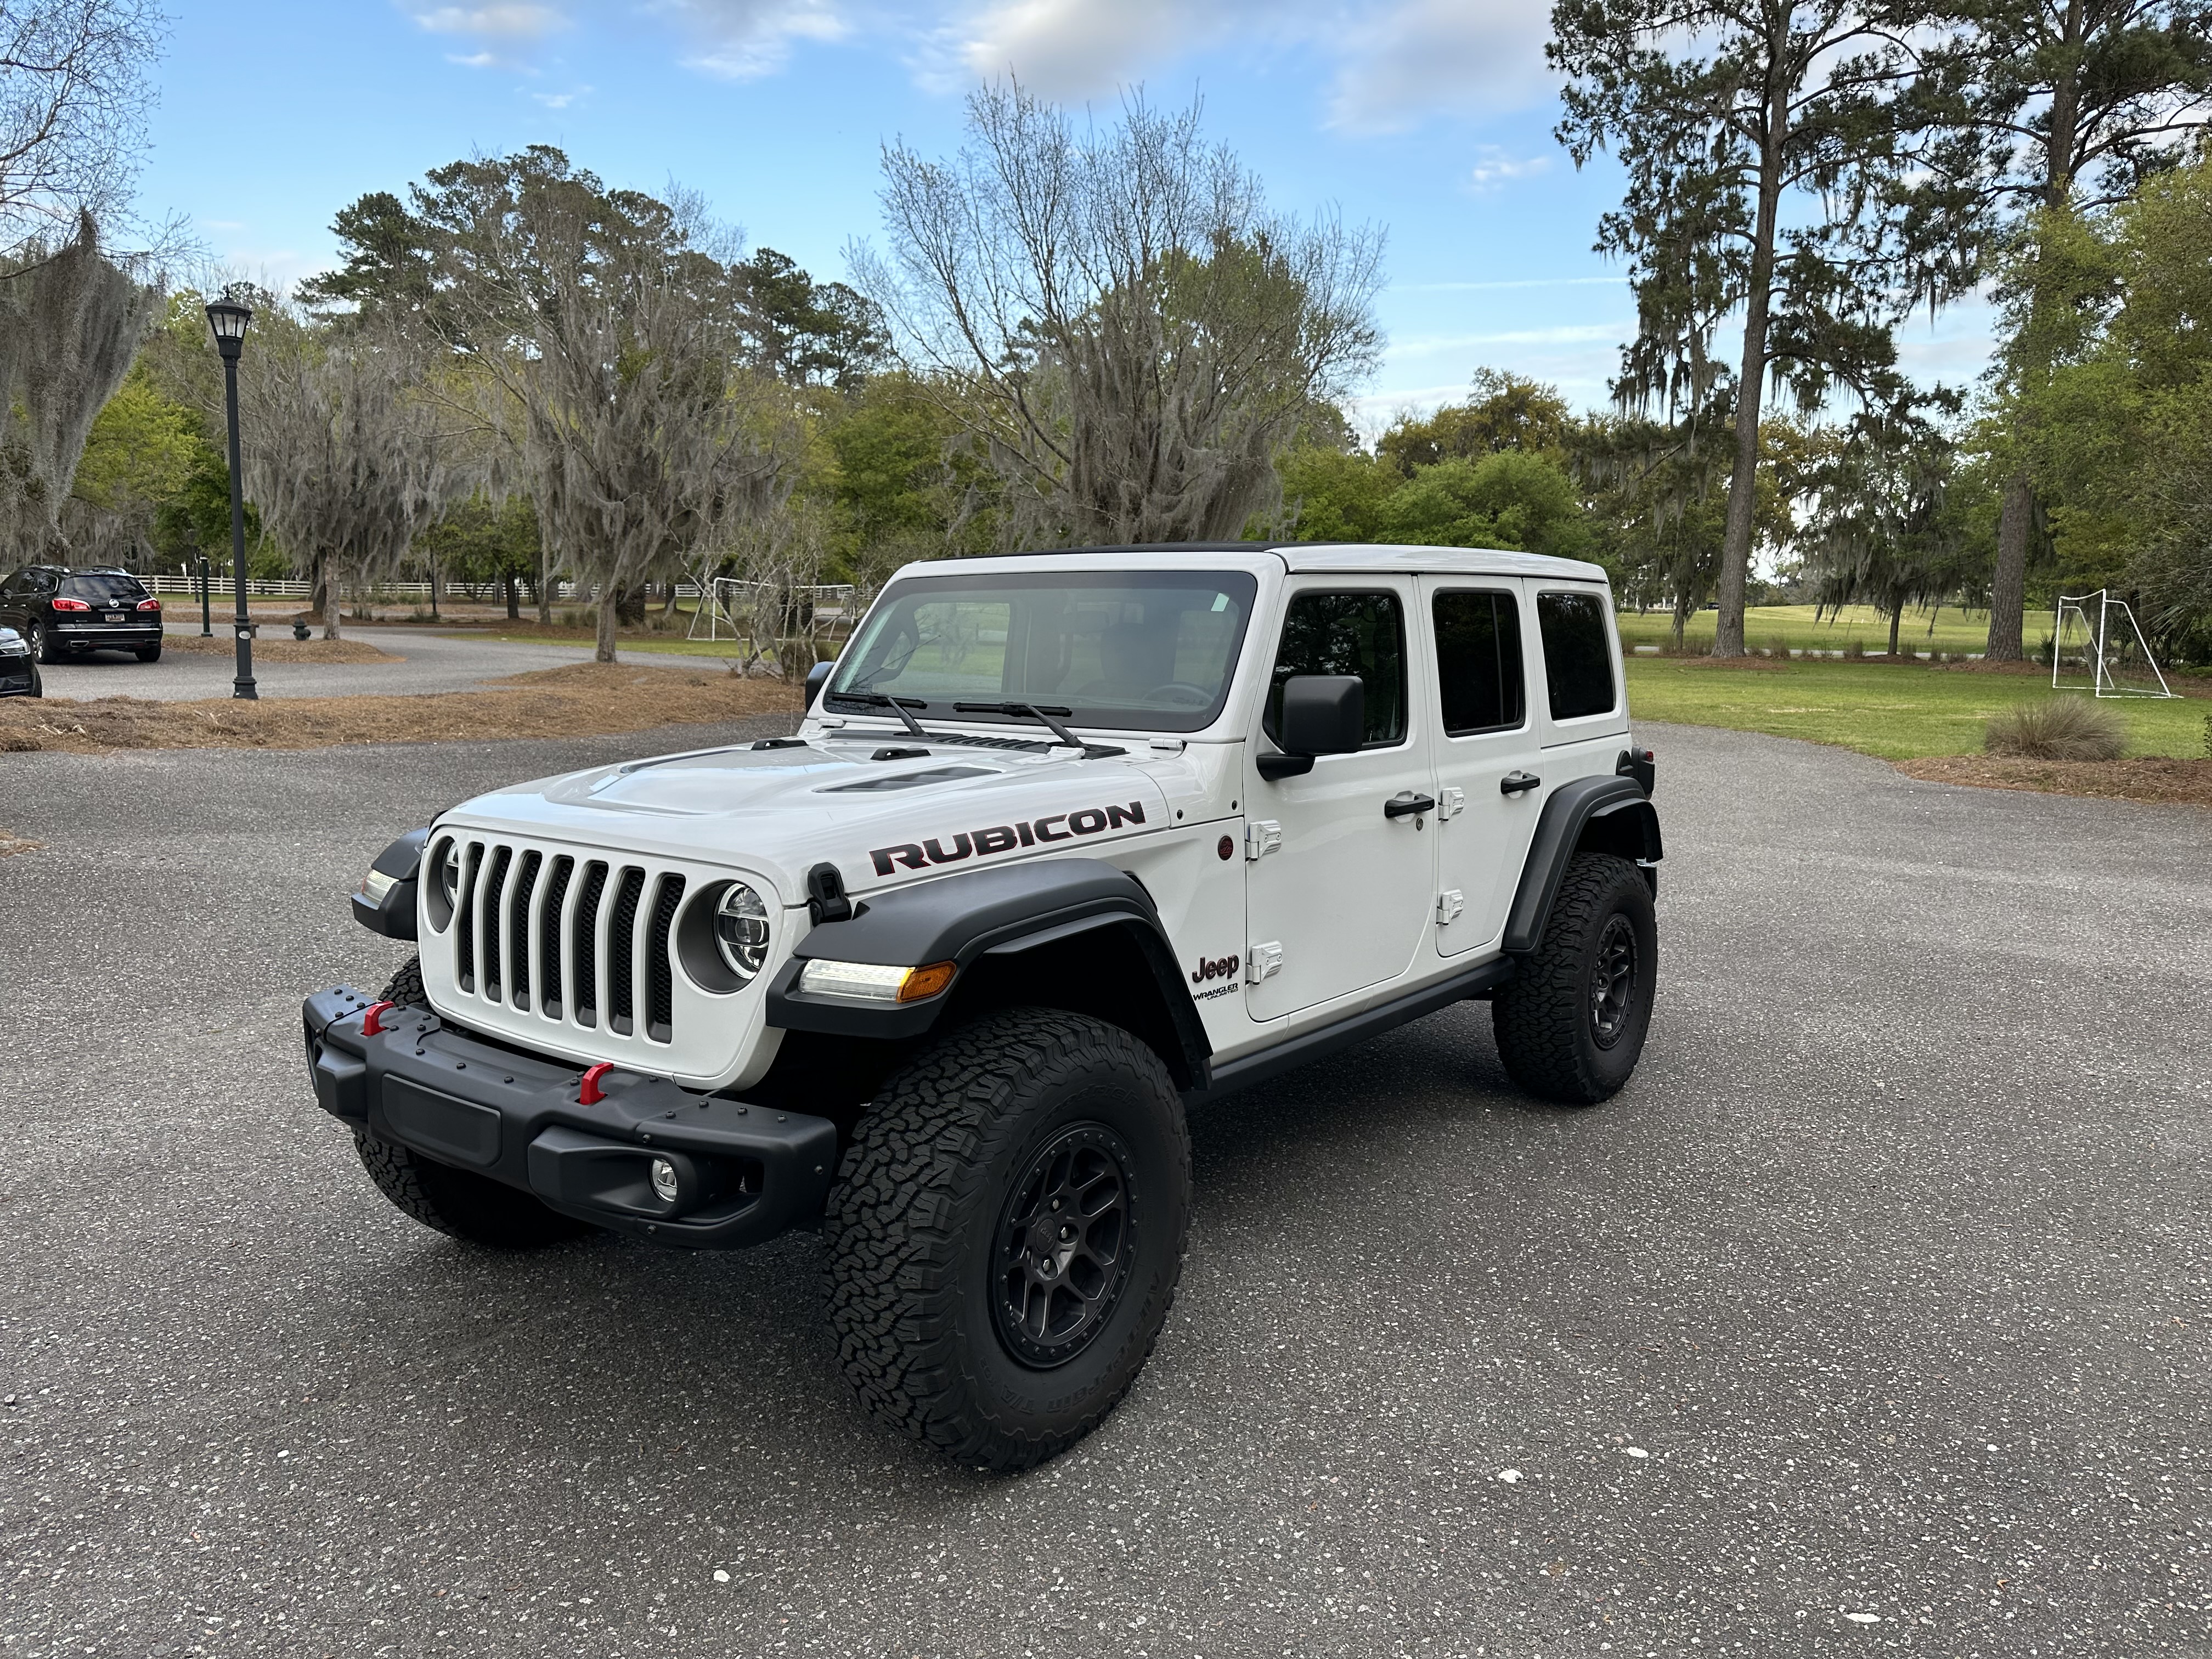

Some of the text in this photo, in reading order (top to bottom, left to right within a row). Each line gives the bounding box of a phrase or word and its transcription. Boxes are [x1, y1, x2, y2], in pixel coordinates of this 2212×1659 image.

[869, 801, 1146, 877] RUBICON
[1192, 954, 1239, 983] Jeep
[1193, 983, 1238, 1001] WRANGLER
[1207, 988, 1239, 1001] UNLIMITED
